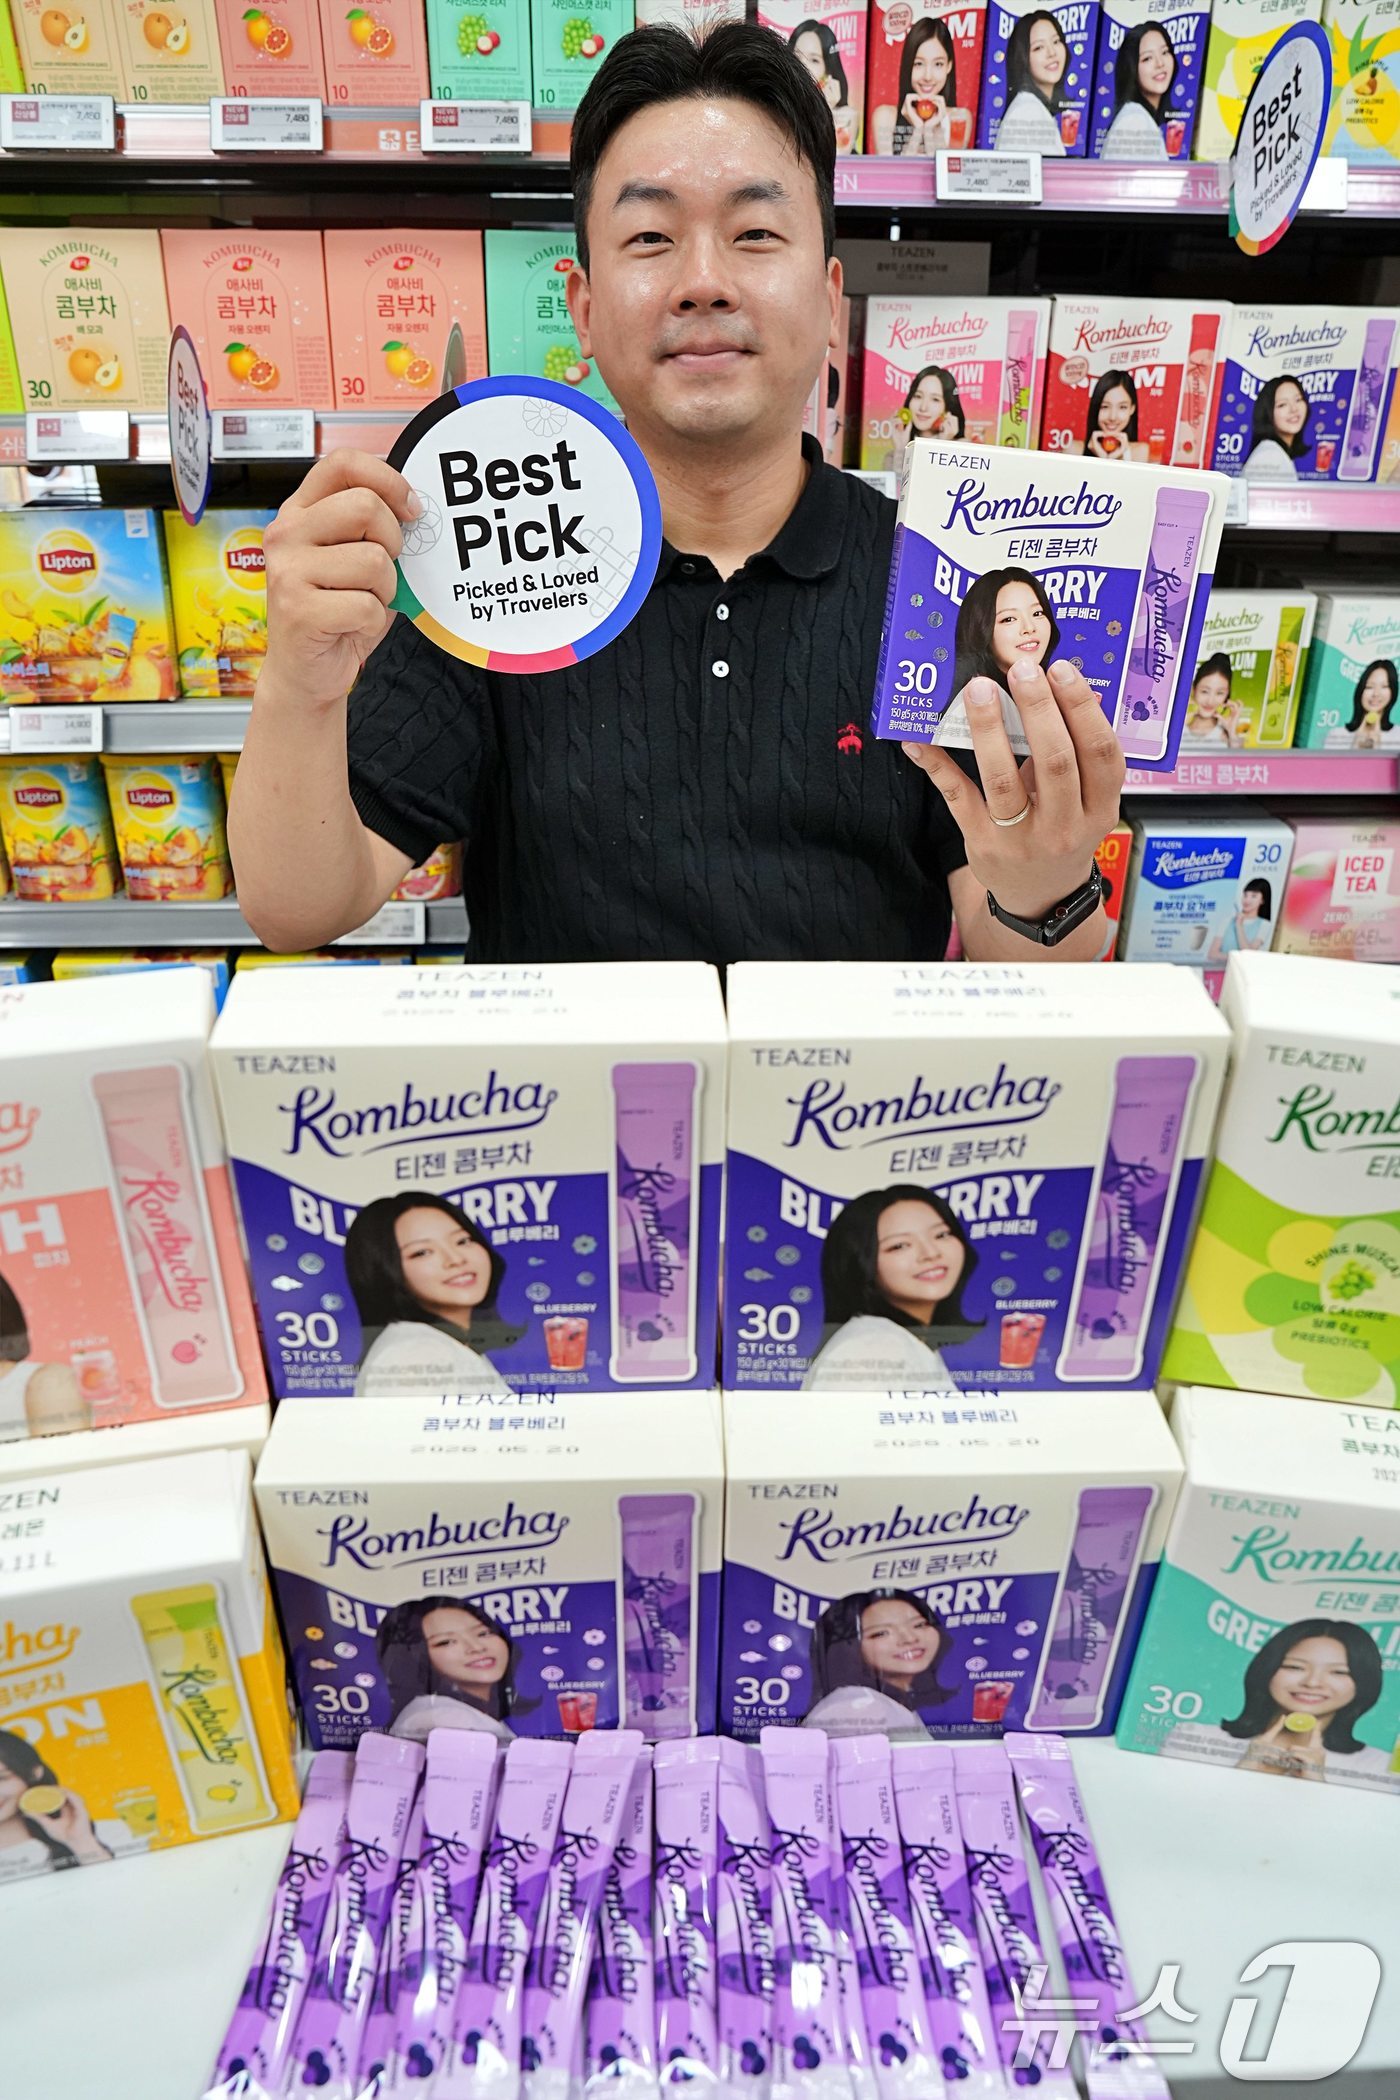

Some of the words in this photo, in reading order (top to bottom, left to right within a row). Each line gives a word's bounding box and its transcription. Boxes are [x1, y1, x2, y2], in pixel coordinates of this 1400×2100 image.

[132, 85, 148, 100] 10
[332, 85, 348, 99] 10
[437, 86, 452, 99] 10
[540, 89, 555, 103] 10
[1253, 62, 1302, 148] Best
[285, 113, 310, 123] 7,480
[495, 115, 519, 125] 7,480
[1253, 111, 1302, 190] Pick
[39, 242, 119, 268] KOMBUCHA
[203, 244, 282, 269] KOMBUCHA
[364, 243, 442, 268] KOMBUCHA
[64, 278, 103, 291] 애사비
[226, 278, 264, 291] 애사비
[386, 277, 424, 291] 애사비
[56, 296, 118, 319] 콤부차
[217, 296, 278, 319] 콤부차
[376, 295, 437, 318] 콤부차
[875, 303, 912, 313] TEAZEN
[1064, 305, 1100, 315] TEAZEN
[1238, 311, 1274, 320] TEAZEN
[887, 312, 989, 350] Kombucha
[1073, 315, 1173, 352] Kombucha
[1246, 319, 1348, 358] Kombucha
[28, 380, 52, 399] 30
[341, 378, 366, 396] 30
[868, 420, 892, 440] 30
[1048, 429, 1074, 449] 30
[1216, 434, 1243, 454] 30
[929, 451, 991, 471] TEAZEN
[438, 439, 582, 507] Best
[941, 478, 1122, 536] Kombucha
[452, 503, 590, 571] Pick
[1007, 538, 1042, 559] 티젠
[1046, 537, 1098, 558] 콤부차
[43, 554, 92, 571] Lipton
[230, 552, 266, 569] Lipto
[1183, 535, 1195, 568] TEAZEN
[453, 577, 519, 601] Picked
[523, 574, 537, 592] &
[541, 566, 600, 590] Loved
[470, 602, 494, 622] by
[496, 590, 588, 617] Travelers
[1056, 606, 1101, 621] 블루베리
[1144, 563, 1182, 683] Kombucha
[894, 660, 938, 695] 30
[892, 694, 933, 708] STICKS
[1317, 710, 1340, 727] 30
[1177, 766, 1212, 784] 티젠
[1216, 764, 1269, 784] 콤부차
[18, 791, 60, 804] Lipton
[129, 791, 171, 805] Lipton
[1151, 841, 1183, 849] TEAZEN
[1254, 844, 1282, 864] 30
[1153, 848, 1234, 877] Kombucha
[1344, 856, 1385, 873] ICED
[1345, 876, 1377, 893] TEA
[413, 970, 544, 982] TEAZEN
[234, 1056, 337, 1075] TEAZEN
[750, 1048, 852, 1067] TEAZEN
[1266, 1044, 1367, 1075] TEAZEN
[277, 1069, 559, 1158] Kombucha
[781, 1062, 1063, 1151] Kombucha
[396, 1152, 447, 1180] 티젠
[453, 1141, 533, 1175] 콤부차
[889, 1144, 940, 1173] 티젠
[947, 1134, 1029, 1168] 콤부차
[491, 1225, 560, 1246] 블루베리
[623, 1162, 685, 1299] Kombucha
[969, 1219, 1038, 1240] 블루베리
[1101, 1156, 1156, 1295] Kombucha
[122, 1171, 208, 1314] Kombucha
[1304, 1243, 1349, 1268] SHINE
[533, 1302, 597, 1315] BLUEBERRY
[995, 1299, 1059, 1310] BLUEBERRY
[1293, 1300, 1325, 1313] LOW
[1329, 1304, 1388, 1322] CALORIE
[274, 1311, 340, 1349] 30
[737, 1303, 801, 1341] 30
[737, 1343, 798, 1356] STICKS
[1291, 1331, 1371, 1350] PREBIOTICS
[280, 1350, 342, 1363] STICKS
[422, 1416, 480, 1431] 콤부차
[488, 1416, 567, 1431] 블루베리
[878, 1410, 935, 1425] 콤부차
[942, 1409, 1018, 1424] 블루베리
[276, 1489, 369, 1505] TEAZEN
[747, 1483, 839, 1499] TEAZEN
[1208, 1492, 1301, 1520] TEAZEN
[316, 1501, 570, 1571] Kombucha
[775, 1494, 1031, 1563] Kombucha
[422, 1562, 468, 1588] 티젠
[475, 1556, 547, 1583] 콤부차
[872, 1557, 921, 1580] 티젠
[925, 1549, 998, 1576] 콤부차
[1315, 1591, 1366, 1610] 티젠
[509, 1619, 572, 1637] 블루베리
[945, 1611, 1007, 1629] 블루베리
[547, 1680, 606, 1690] BLUEBERRY
[968, 1670, 1025, 1680] BLUEBERRY
[312, 1684, 370, 1714] 30
[733, 1677, 790, 1706] 30
[1142, 1684, 1203, 1721] 30
[162, 1664, 244, 1766] Kombucha
[317, 1714, 372, 1725] STICKS
[732, 1705, 788, 1717] STICKS
[470, 1789, 483, 1831] TEAZEN
[541, 1792, 557, 1831] TEAZEN
[602, 1783, 620, 1825] TEAZEN
[634, 1795, 644, 1836] TEAZEN
[701, 1791, 710, 1835] TEAZEN
[814, 1783, 824, 1825] TEAZEN
[878, 1786, 891, 1825] TEAZEN
[939, 1794, 953, 1835] TEAZEN
[1067, 1786, 1086, 1825] TEAZEN
[1001, 1799, 1015, 1841] TEAZEN
[417, 1830, 469, 2005] Kombucha
[483, 1830, 539, 1992] Kombucha
[541, 1826, 599, 1998] Kombucha
[843, 1827, 914, 1993] Kombucha
[1040, 1823, 1124, 1991] Kombucha
[256, 1846, 329, 2020] Kombucha
